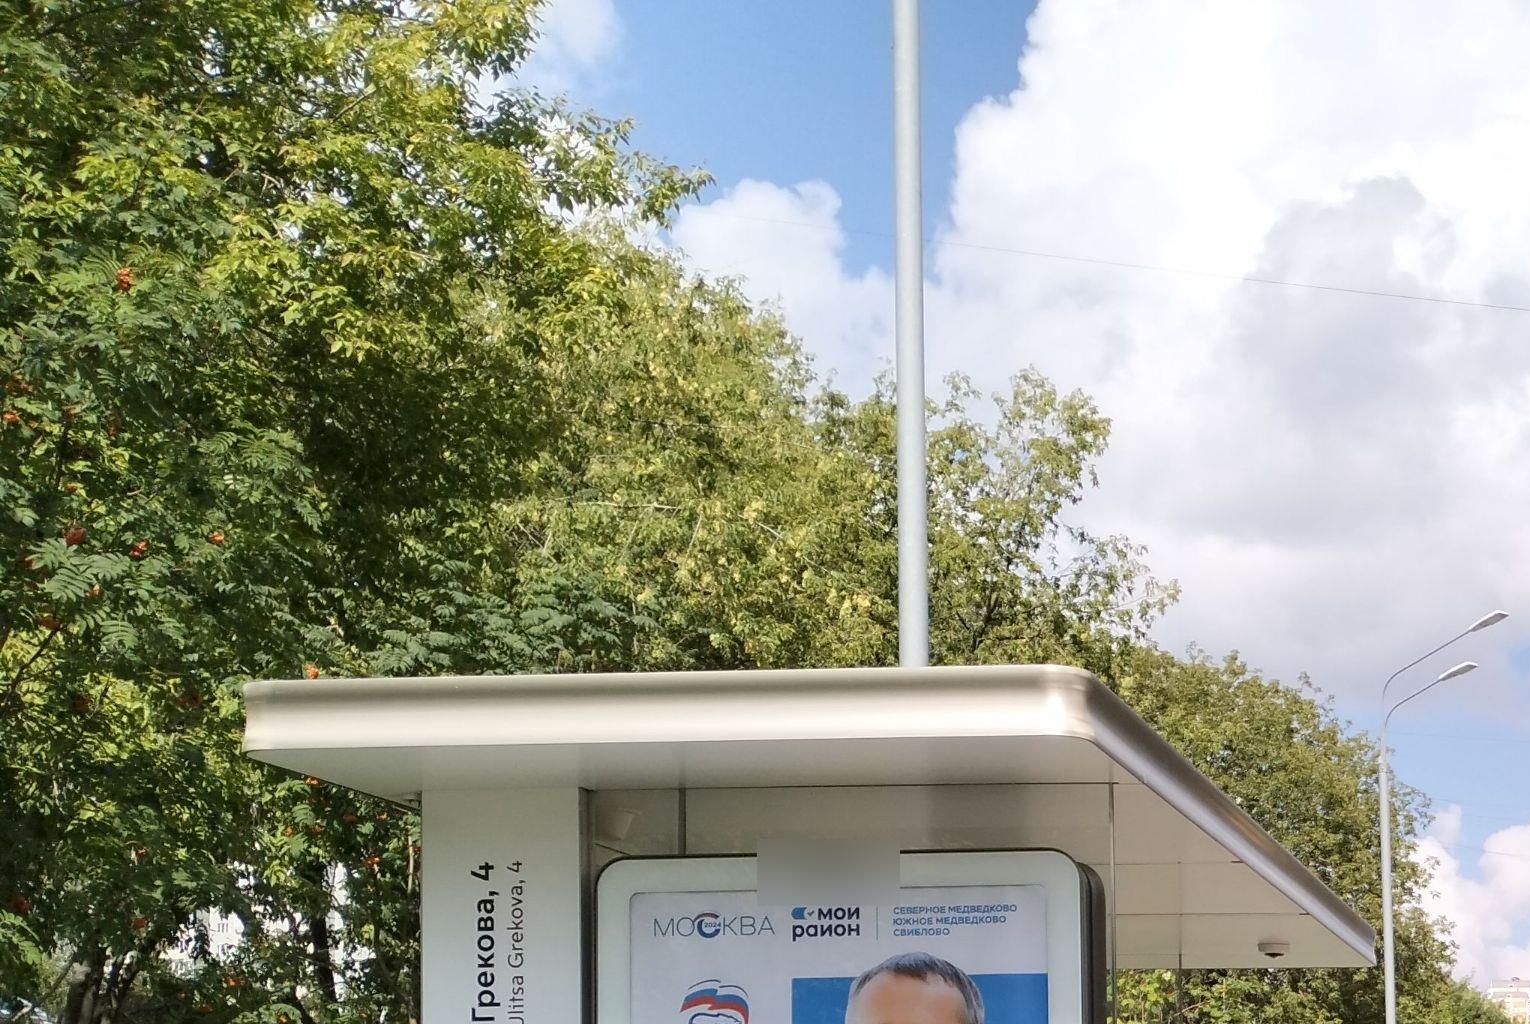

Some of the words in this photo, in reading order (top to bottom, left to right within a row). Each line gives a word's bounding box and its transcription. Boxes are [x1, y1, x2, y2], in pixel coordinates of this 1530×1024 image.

[470, 861, 495, 881] 4
[506, 860, 523, 873] 4
[893, 905, 946, 915] СЕВЕРНОЕ
[948, 904, 1017, 914] МЕДВЕДКОВО
[507, 879, 526, 968] Grekova,
[653, 912, 775, 939] МОСКВА
[893, 917, 933, 926] ЮЖНОЕ
[935, 915, 1007, 925] МЕДВЕДКОВО
[893, 928, 950, 936] СВИБЛОВО
[471, 890, 500, 1023] Грекова,
